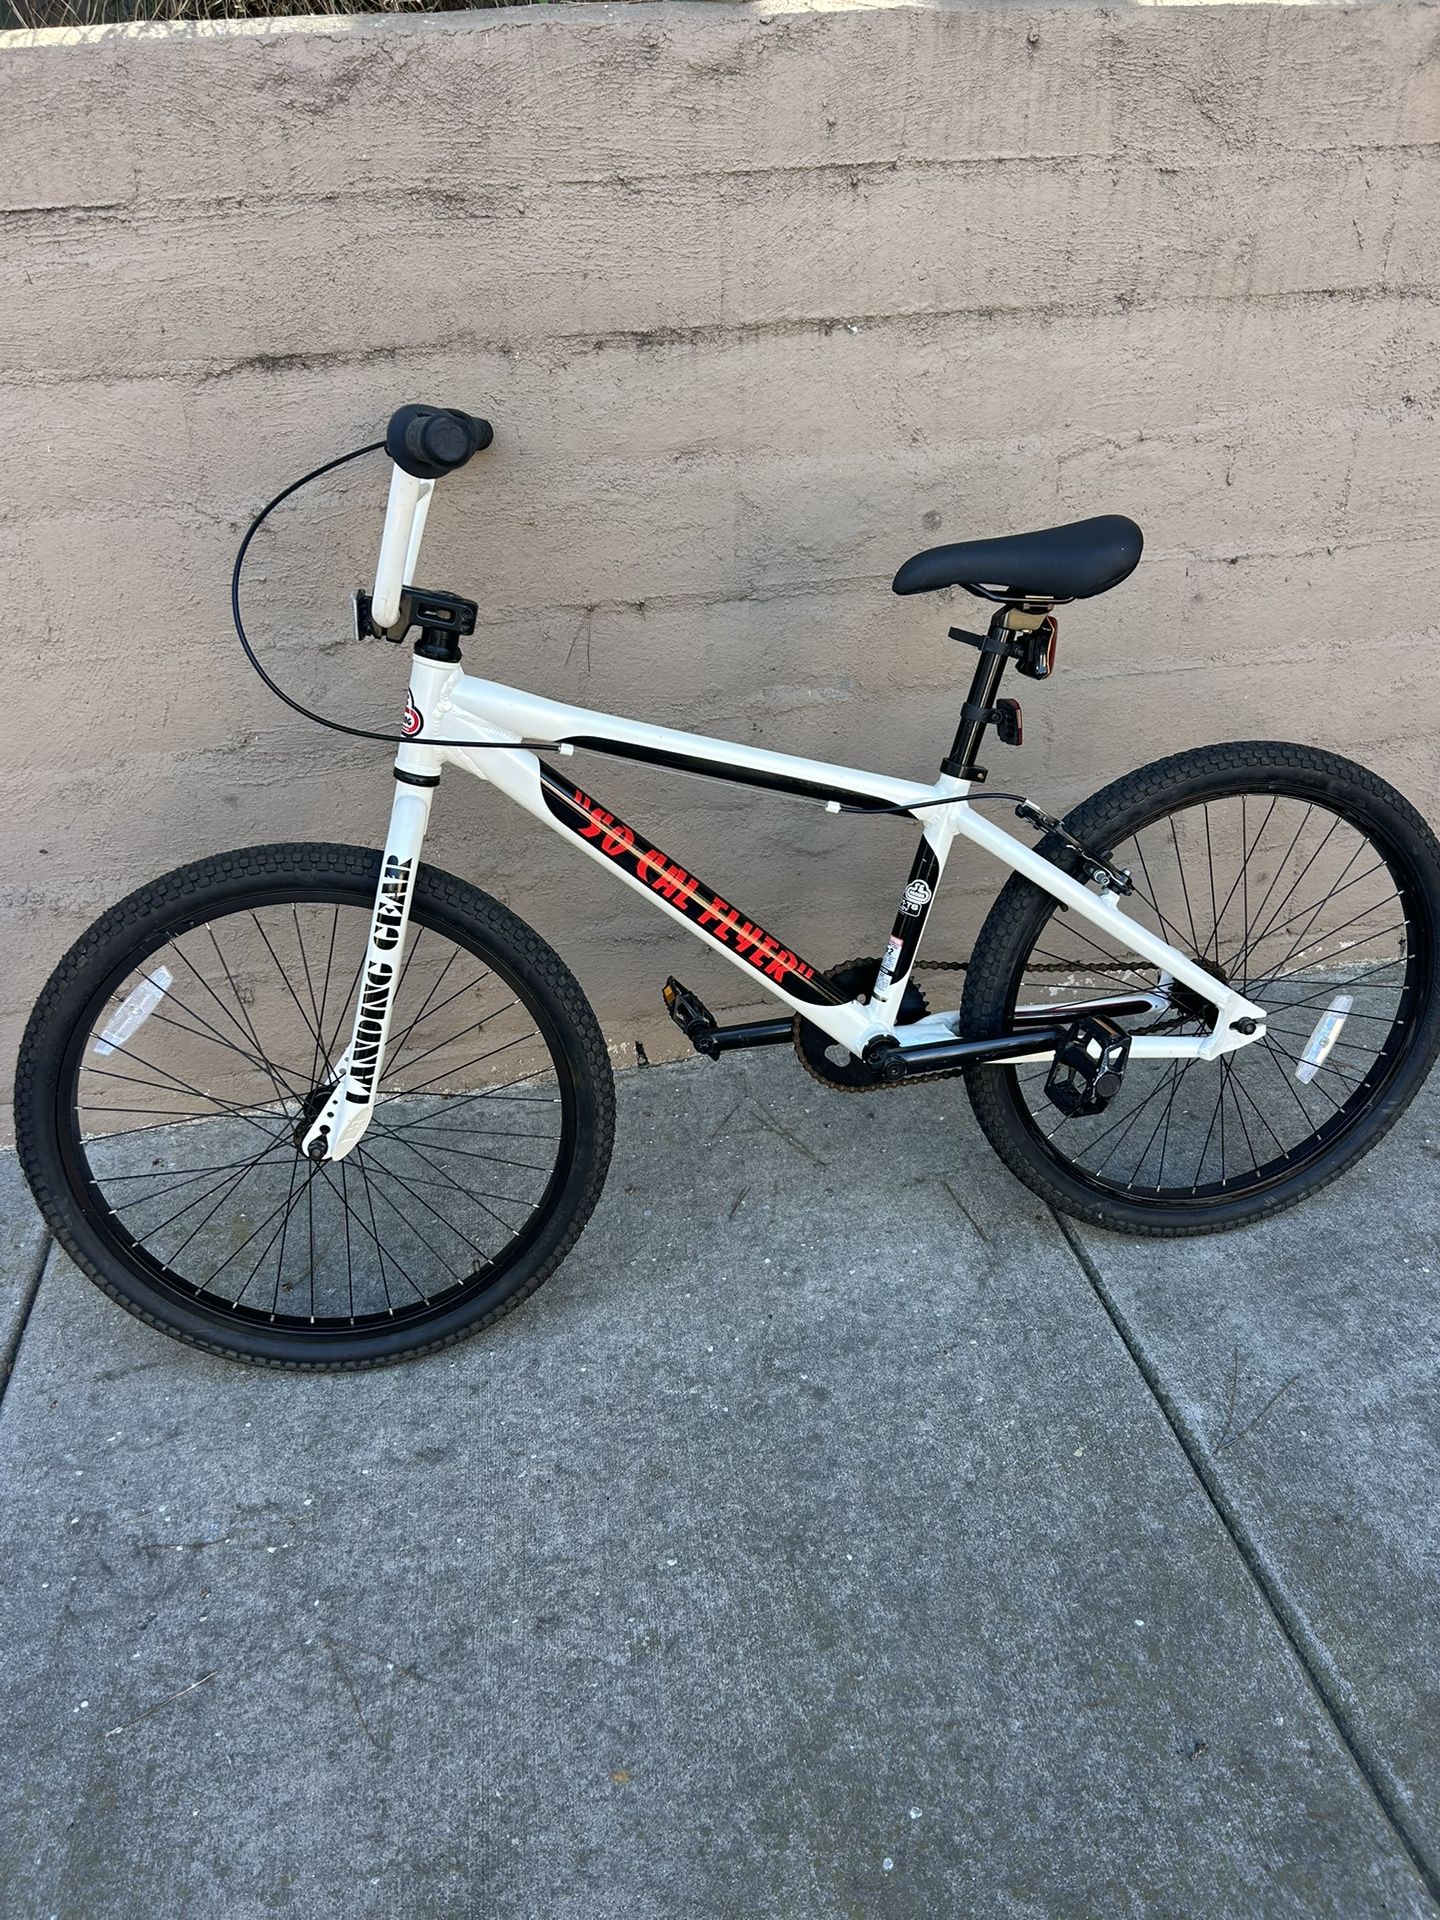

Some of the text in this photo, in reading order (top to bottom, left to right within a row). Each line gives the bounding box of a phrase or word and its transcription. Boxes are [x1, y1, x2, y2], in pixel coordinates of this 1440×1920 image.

[636, 849, 700, 910] CAL
[345, 854, 413, 1105] LANDING GEAR
